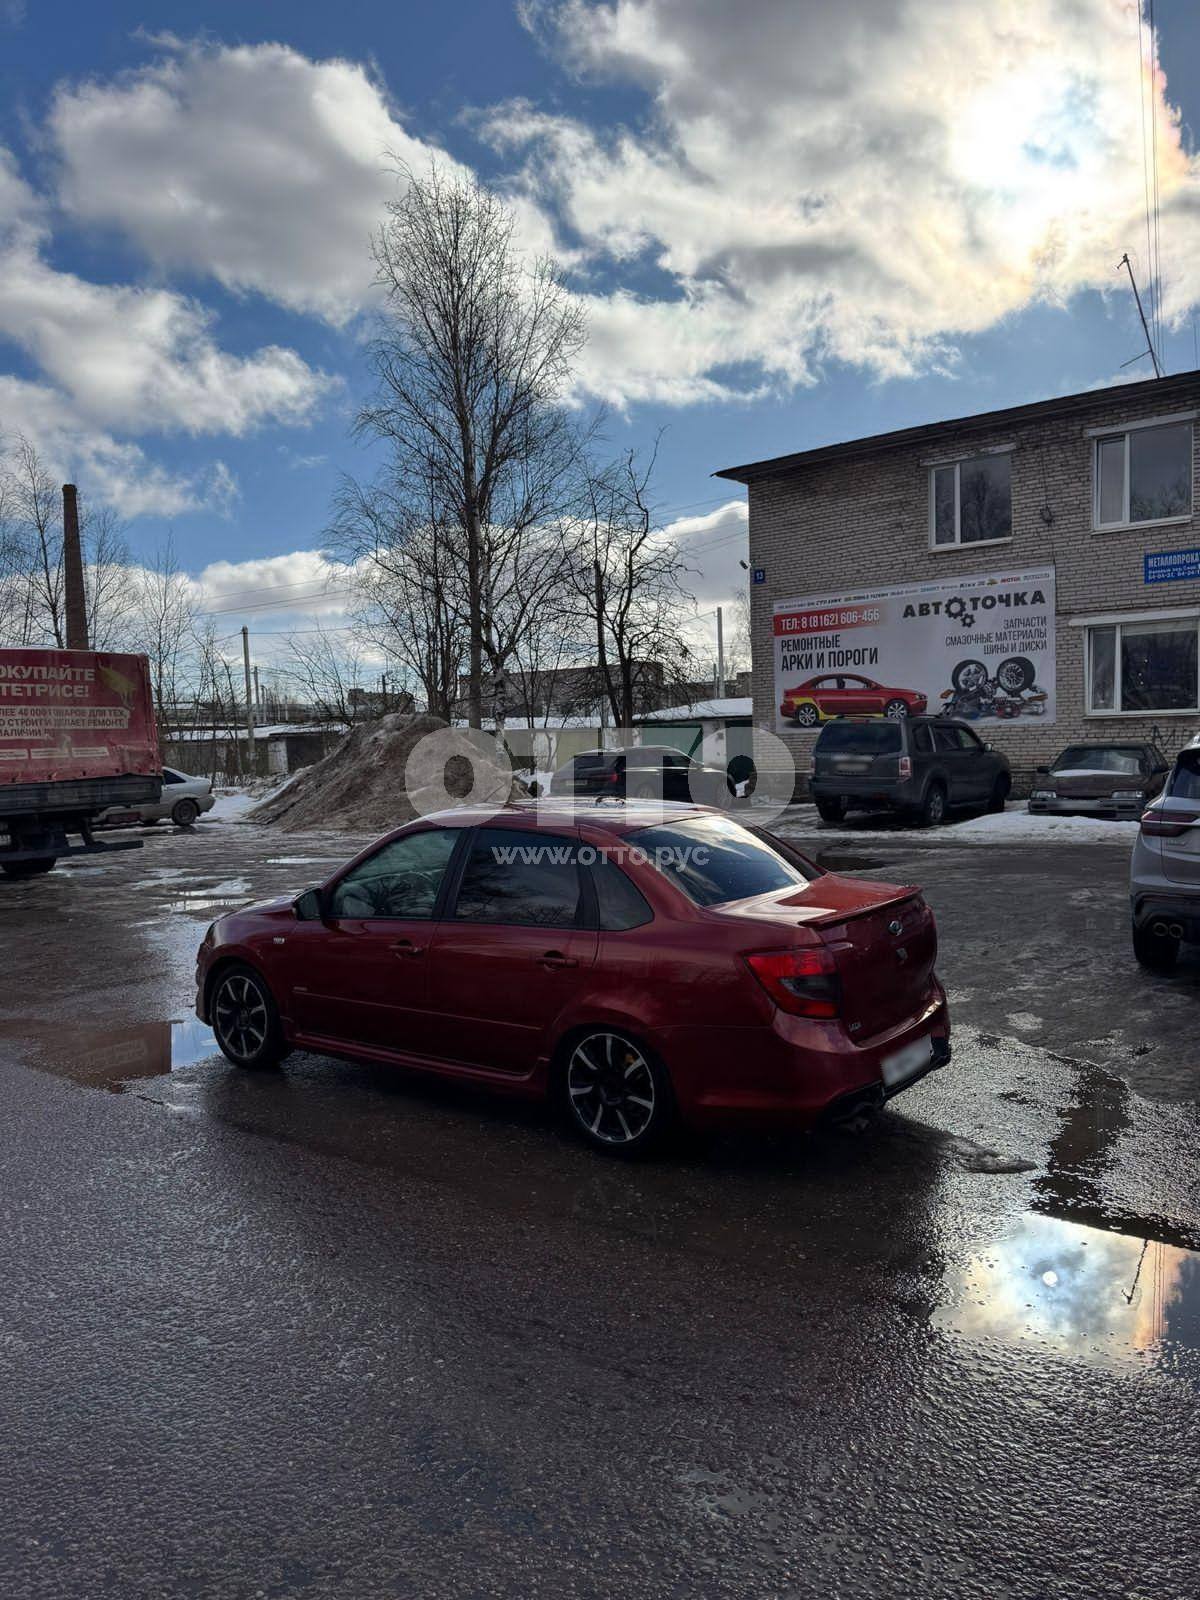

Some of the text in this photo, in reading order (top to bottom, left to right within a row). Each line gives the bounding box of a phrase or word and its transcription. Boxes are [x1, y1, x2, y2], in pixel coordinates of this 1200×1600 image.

[1148, 552, 1200, 568] МЕТАЛЛОПРОКА
[781, 608, 880, 631] ТЕЛ: 8 (8162) 606-456
[1003, 616, 1047, 630] ЗАПЧАСТИ
[781, 634, 841, 653] РЕМОНТНЫЕ
[945, 628, 1048, 647] СМАЗОЧНЫЕ МАТЕРИАЛЫ
[983, 640, 1048, 656] ШИНЫ И ДИСКИ
[781, 647, 879, 673] АРКИ И ПОРОГИ
[0, 683, 89, 698] ТЕТРИСЕ!
